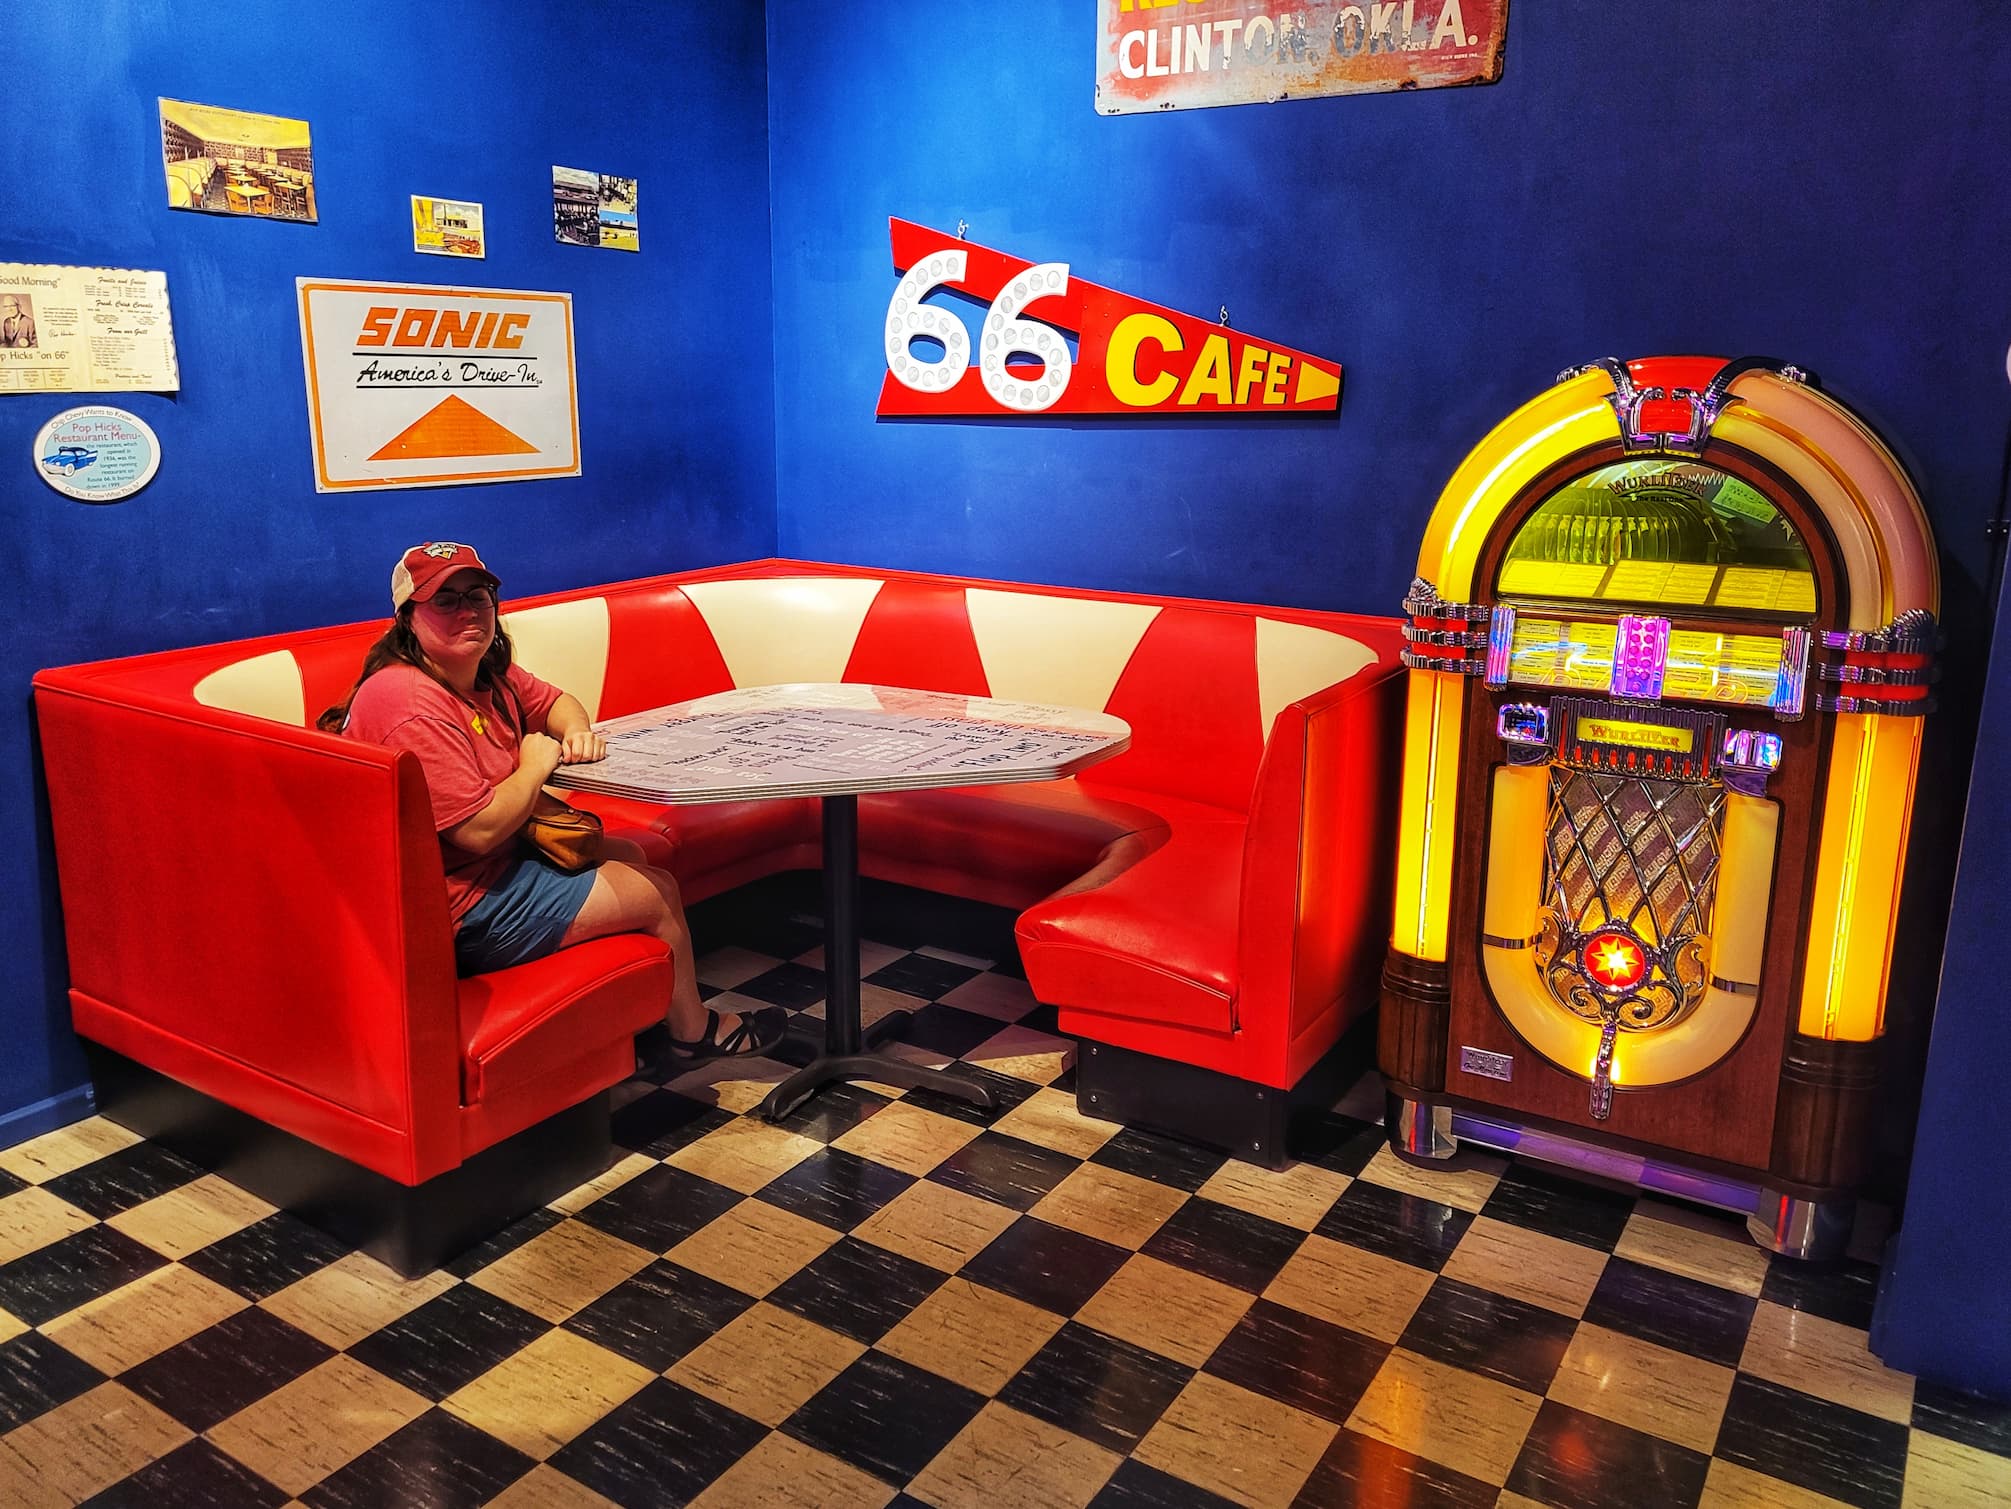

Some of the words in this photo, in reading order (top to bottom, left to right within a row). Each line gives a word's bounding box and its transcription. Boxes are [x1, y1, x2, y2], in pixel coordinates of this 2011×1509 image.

[1333, 0, 1479, 57] OKLA.
[356, 307, 531, 349] SONIC
[885, 249, 1072, 411] 66
[1105, 313, 1293, 406] CAFE
[10, 351, 34, 360] Hicks
[357, 360, 452, 383] America's
[460, 361, 539, 384] Drive-In
[53, 433, 110, 443] Restaurant
[72, 423, 92, 434] Pop
[94, 422, 122, 432] Hicks
